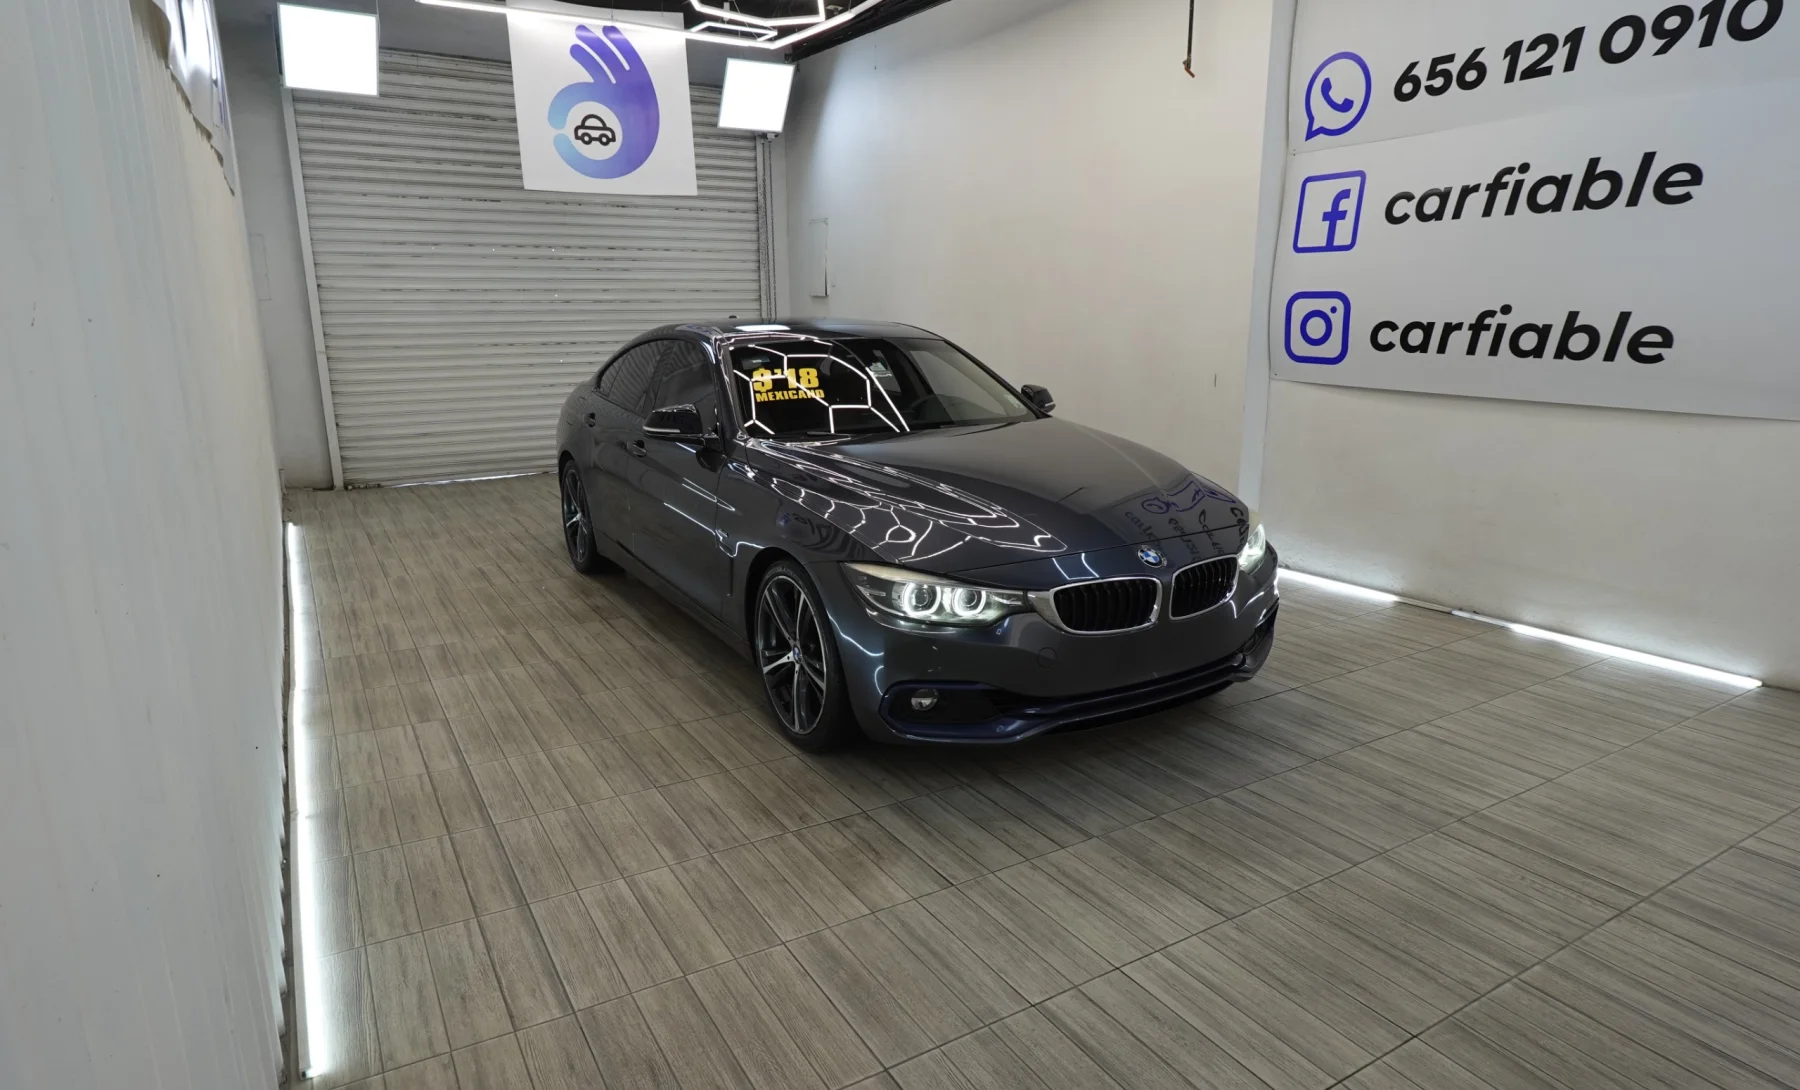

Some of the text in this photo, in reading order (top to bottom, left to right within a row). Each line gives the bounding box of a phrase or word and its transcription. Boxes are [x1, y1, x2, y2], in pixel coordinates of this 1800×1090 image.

[1393, 0, 1784, 102] 656 121 0910
[1384, 151, 1704, 225] carfiable
[1369, 304, 1675, 365] carfiable
[755, 389, 825, 402] MEXICANO
